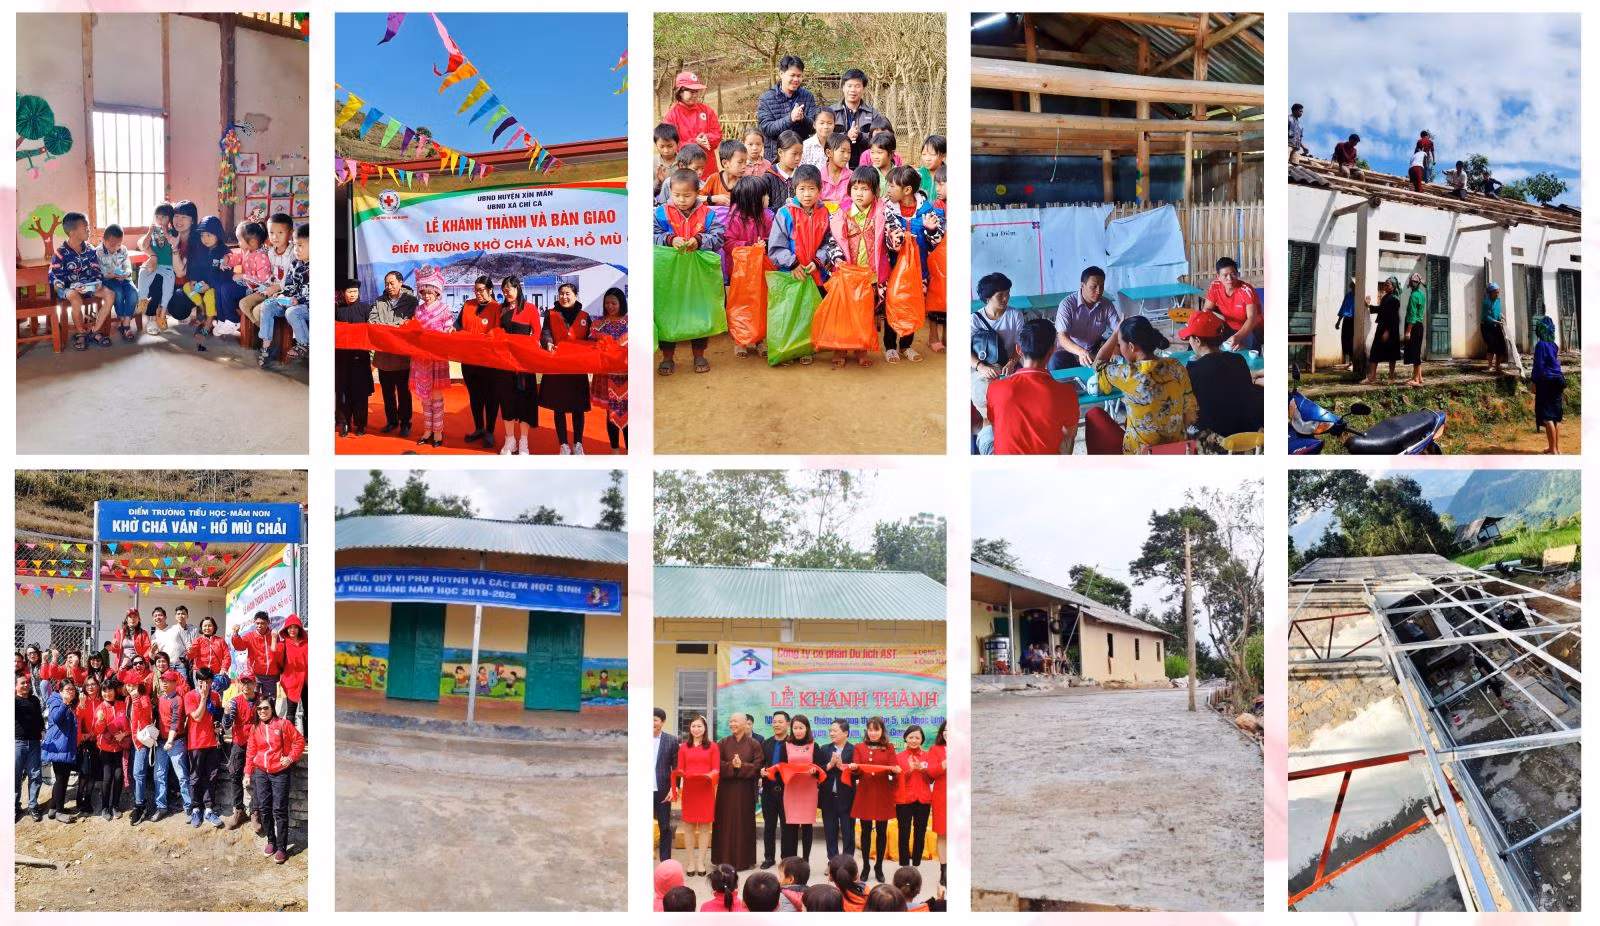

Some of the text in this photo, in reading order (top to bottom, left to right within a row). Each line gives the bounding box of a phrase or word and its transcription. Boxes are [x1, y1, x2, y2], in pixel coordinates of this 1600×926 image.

[498, 192, 520, 200] HUYỆN
[426, 209, 616, 234] LỄ KHÁNH THÀNH VÀ BÀN GIAO
[392, 240, 419, 254] ĐIỂM
[423, 240, 470, 253] TRƯỜNG
[474, 238, 500, 250] KHỜ
[504, 236, 532, 249] CHÁ
[574, 232, 597, 246] HỒ
[600, 231, 622, 245] MÙ
[128, 506, 148, 516] ĐIỂM
[152, 508, 185, 516] TRƯỜNG
[189, 507, 206, 516] TIỂU
[112, 517, 139, 532] KHỜ
[142, 518, 168, 534] CHÁ
[172, 518, 198, 534] VÁN
[210, 518, 228, 534] HỒ
[232, 519, 252, 534] MÙ
[256, 517, 286, 534] CHẢI
[511, 582, 528, 590] EM
[531, 582, 554, 592] HỌC
[556, 585, 582, 594] SINH
[881, 648, 897, 659] AST
[770, 686, 938, 708] LỄ KHÁNH THÀNH
